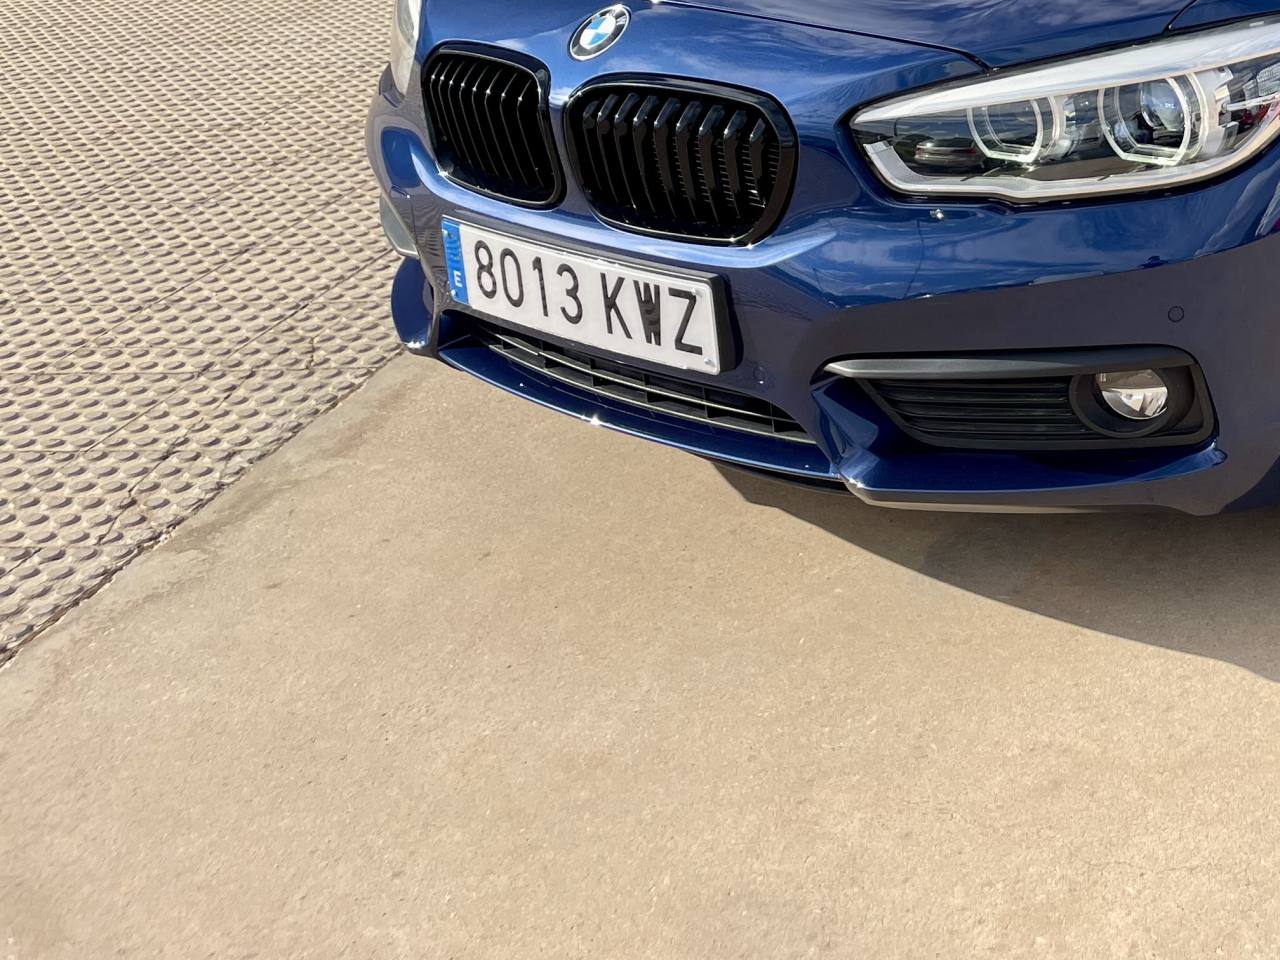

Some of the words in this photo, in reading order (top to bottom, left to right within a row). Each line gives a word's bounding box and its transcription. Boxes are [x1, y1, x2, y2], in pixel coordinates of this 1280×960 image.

[453, 269, 463, 288] E
[473, 239, 584, 327] 8013
[598, 271, 704, 358] KWZ
